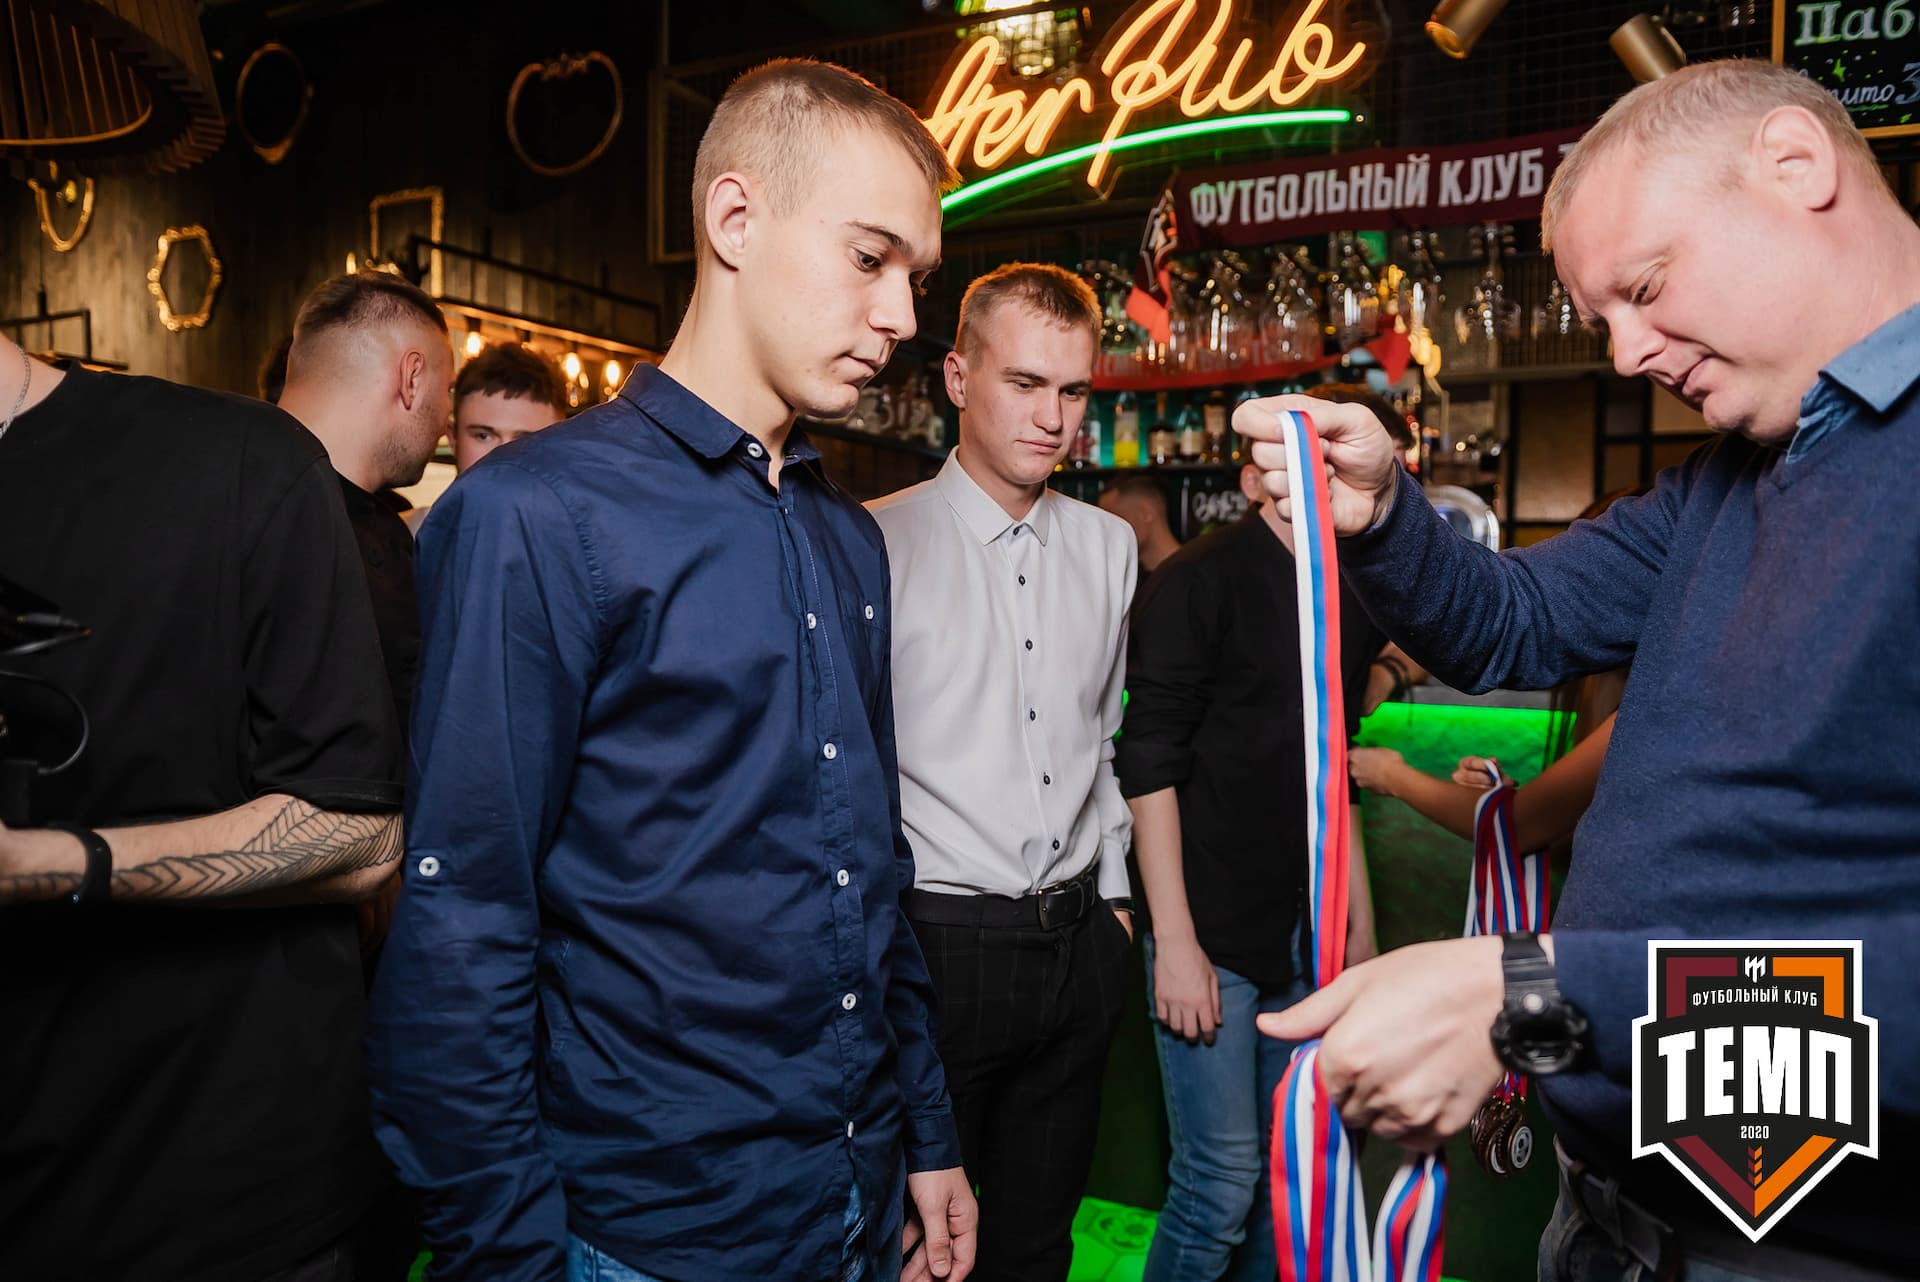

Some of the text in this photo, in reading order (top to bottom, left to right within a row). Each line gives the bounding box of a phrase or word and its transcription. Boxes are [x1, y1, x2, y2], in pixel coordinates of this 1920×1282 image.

[920, 0, 1366, 188] fter Pub
[1190, 148, 1544, 227] ФУТБОЛЬНЫЙ КЛУБ
